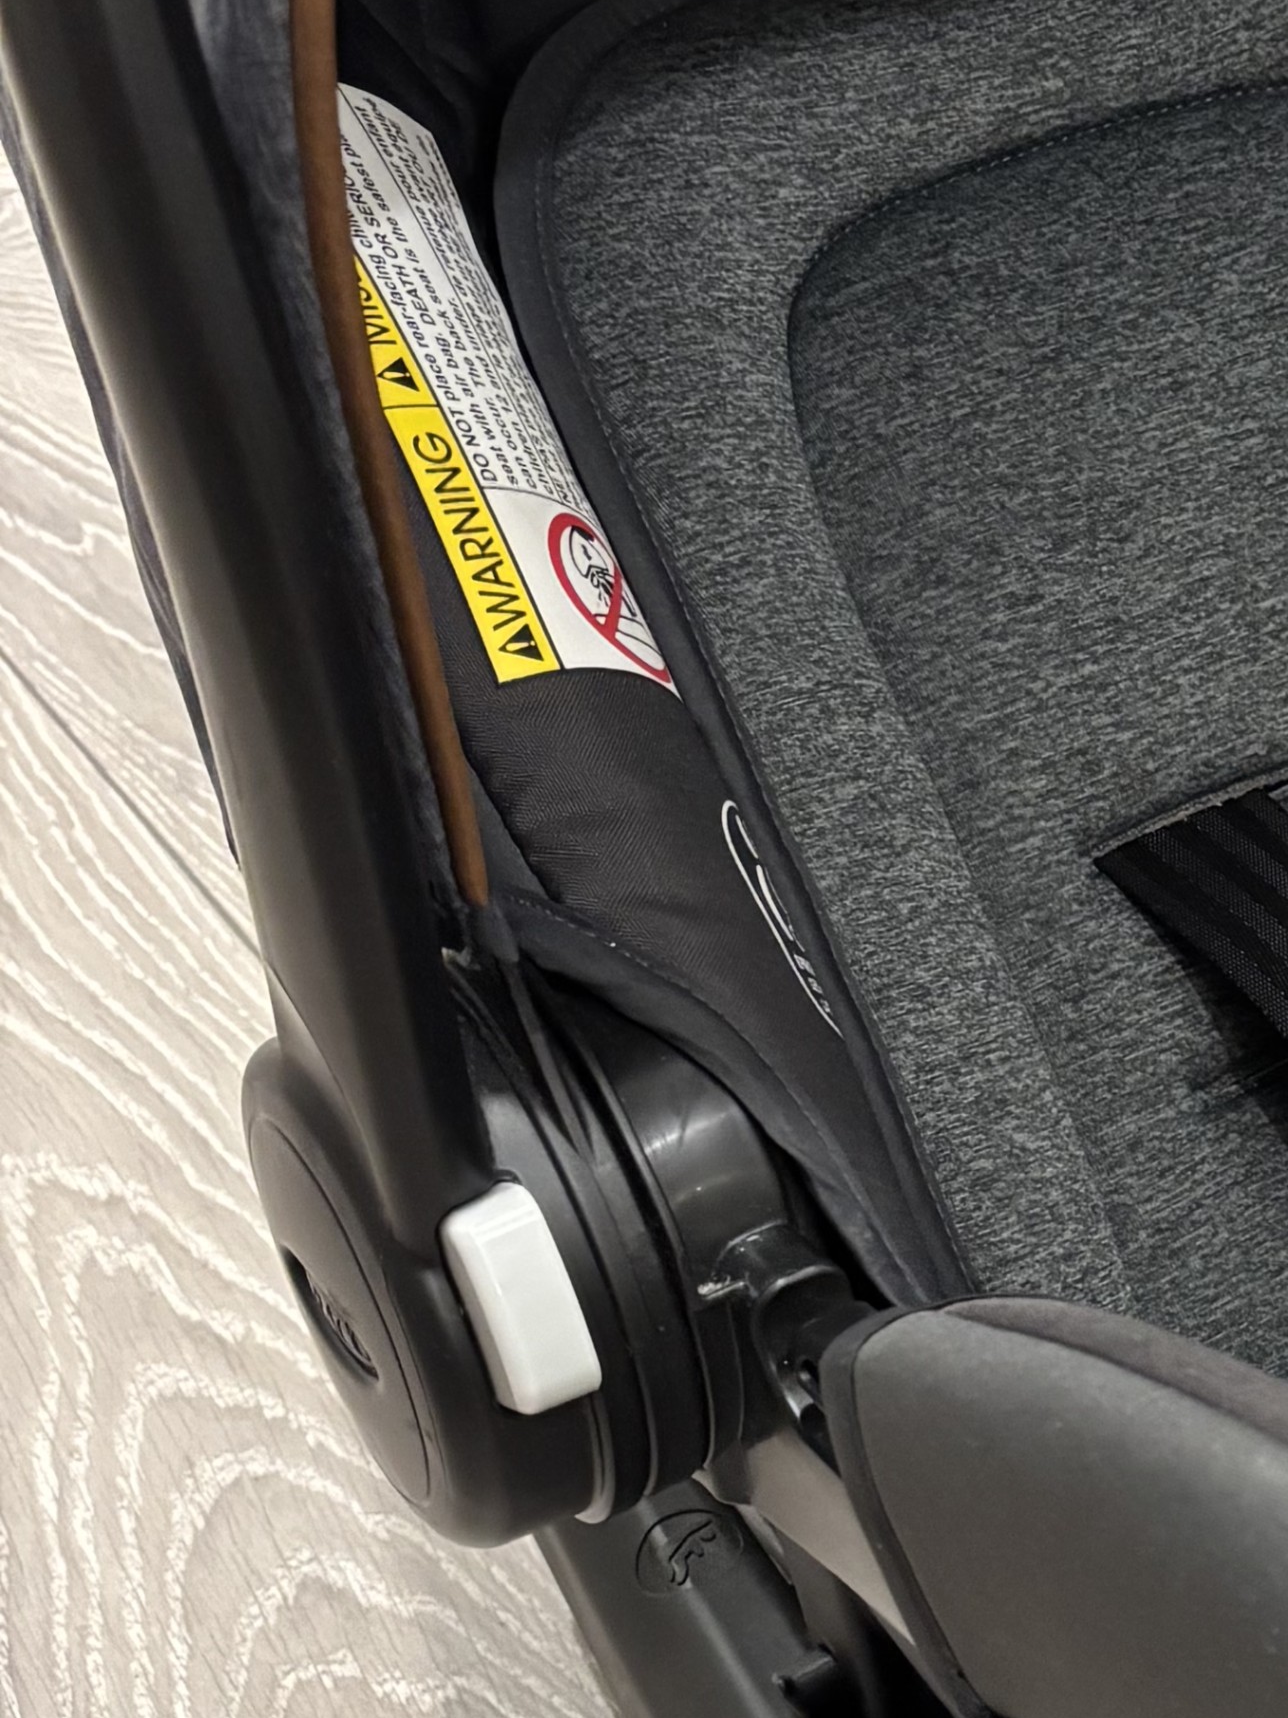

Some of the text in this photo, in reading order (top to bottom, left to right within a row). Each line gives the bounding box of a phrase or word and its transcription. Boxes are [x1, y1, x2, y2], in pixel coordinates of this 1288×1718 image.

[354, 105, 393, 157] enfant
[350, 161, 389, 211] safest
[389, 161, 420, 202] pour
[386, 216, 408, 242] the
[404, 248, 419, 263] is
[367, 253, 429, 347] rear-facing
[412, 267, 441, 304] seat
[341, 163, 518, 485] seat with air bag. DEATH OR SERIO
[437, 309, 466, 351] back
[448, 297, 480, 351] under.
[424, 353, 460, 401] place
[463, 356, 485, 387] The
[475, 355, 501, 389] and
[447, 406, 480, 446] NOT
[484, 397, 517, 450] occur.
[472, 453, 497, 481] DO
[511, 421, 553, 494] children
[514, 456, 537, 489] can
[412, 431, 526, 631] WARNING
